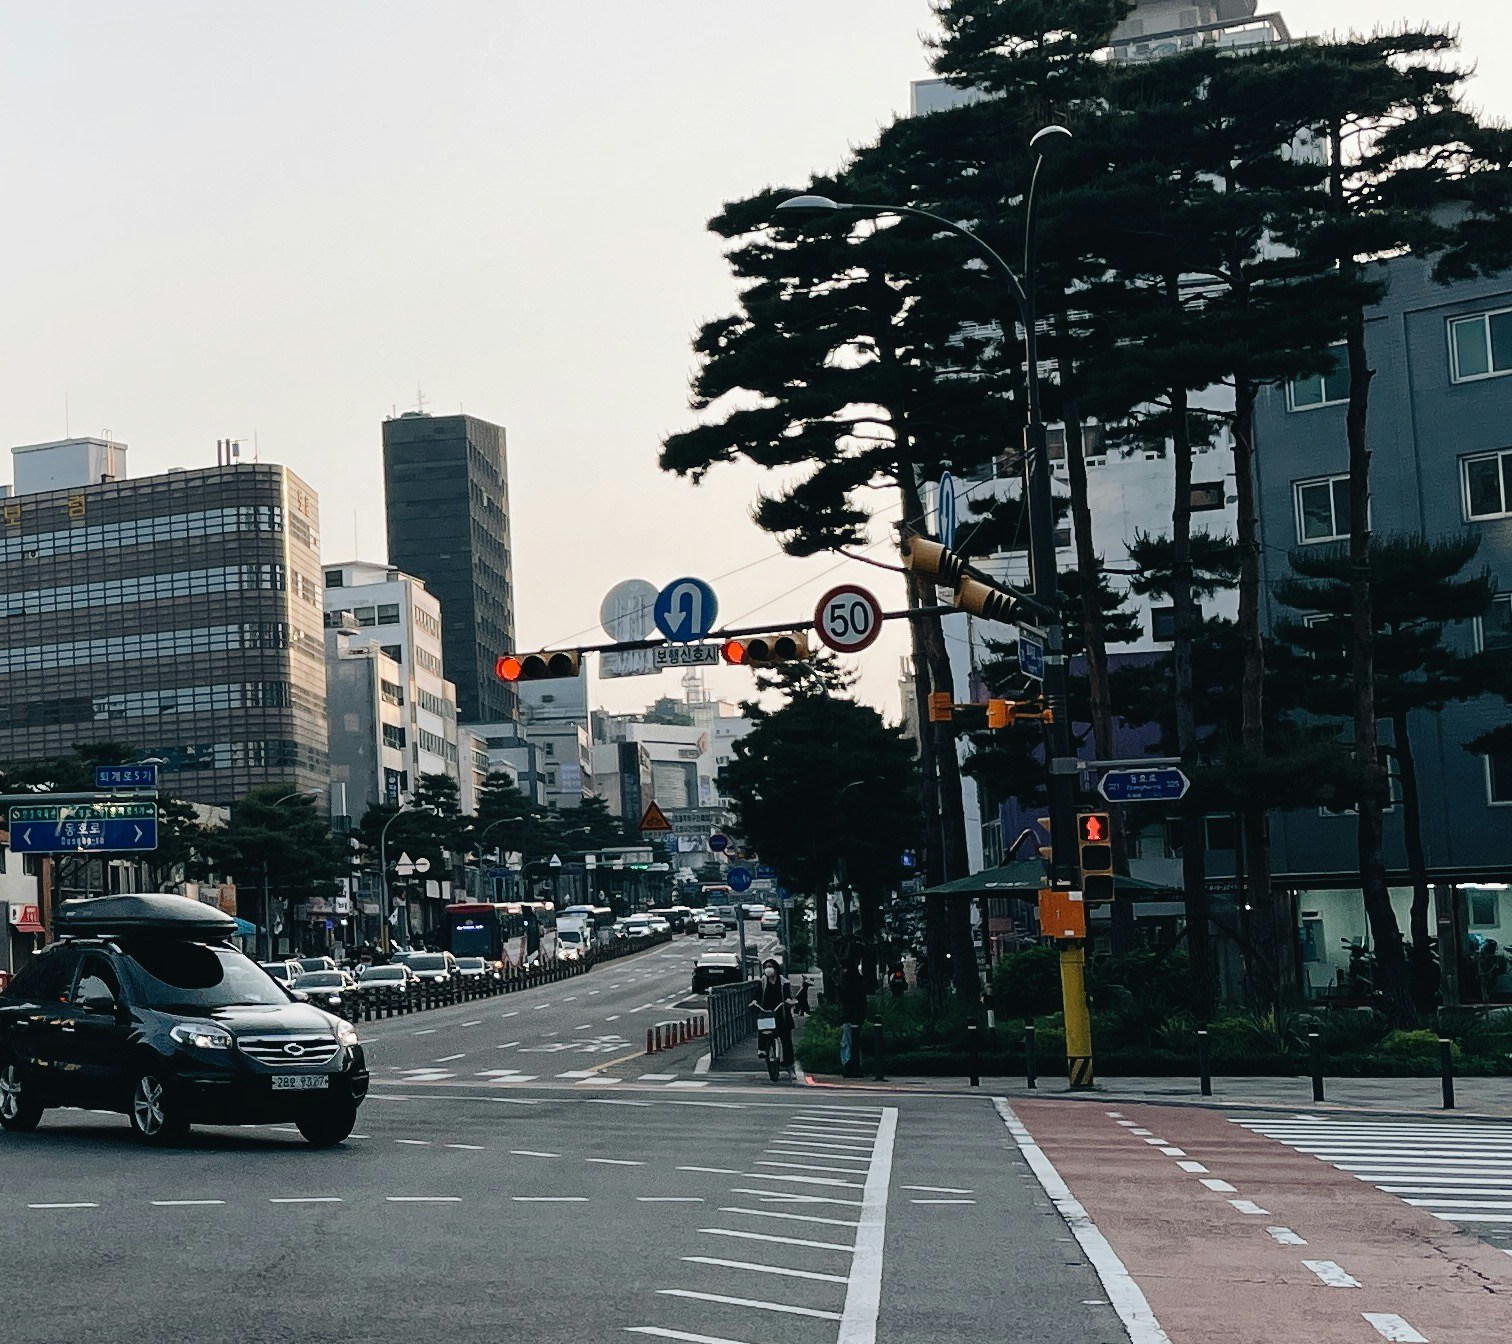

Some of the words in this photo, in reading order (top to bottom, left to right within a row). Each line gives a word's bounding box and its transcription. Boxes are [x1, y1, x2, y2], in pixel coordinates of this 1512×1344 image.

[830, 601, 869, 637] 50
[656, 646, 718, 664] 보행신호시
[64, 822, 101, 837] 동호로
